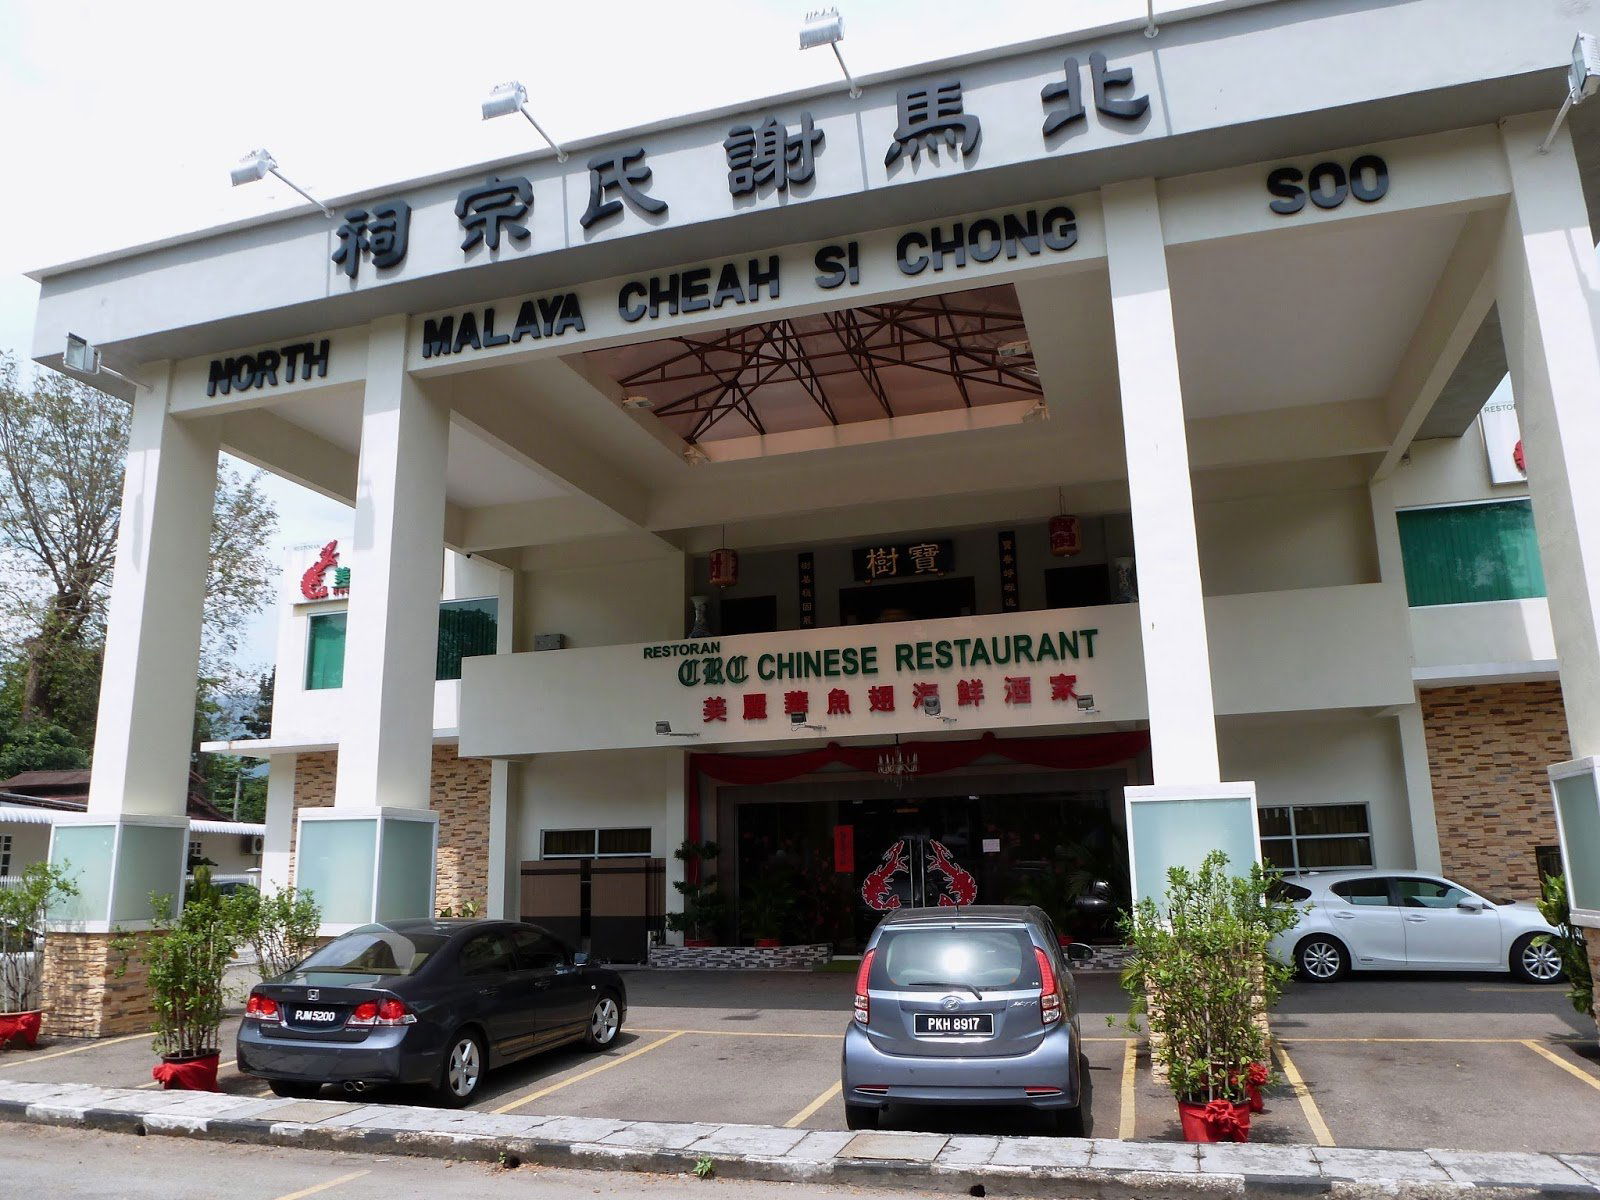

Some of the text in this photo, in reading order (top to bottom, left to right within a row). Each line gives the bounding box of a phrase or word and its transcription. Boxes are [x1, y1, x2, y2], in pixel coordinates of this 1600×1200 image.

[207, 155, 1390, 396] NORTH MALAYA CHEAH SI CHONG SOO
[643, 641, 721, 660] RESTORAN
[757, 646, 879, 681] CHINESE
[895, 629, 1099, 673] RESTAURANT
[312, 1011, 336, 1022] 5200
[928, 1017, 980, 1031] PKH 8917
